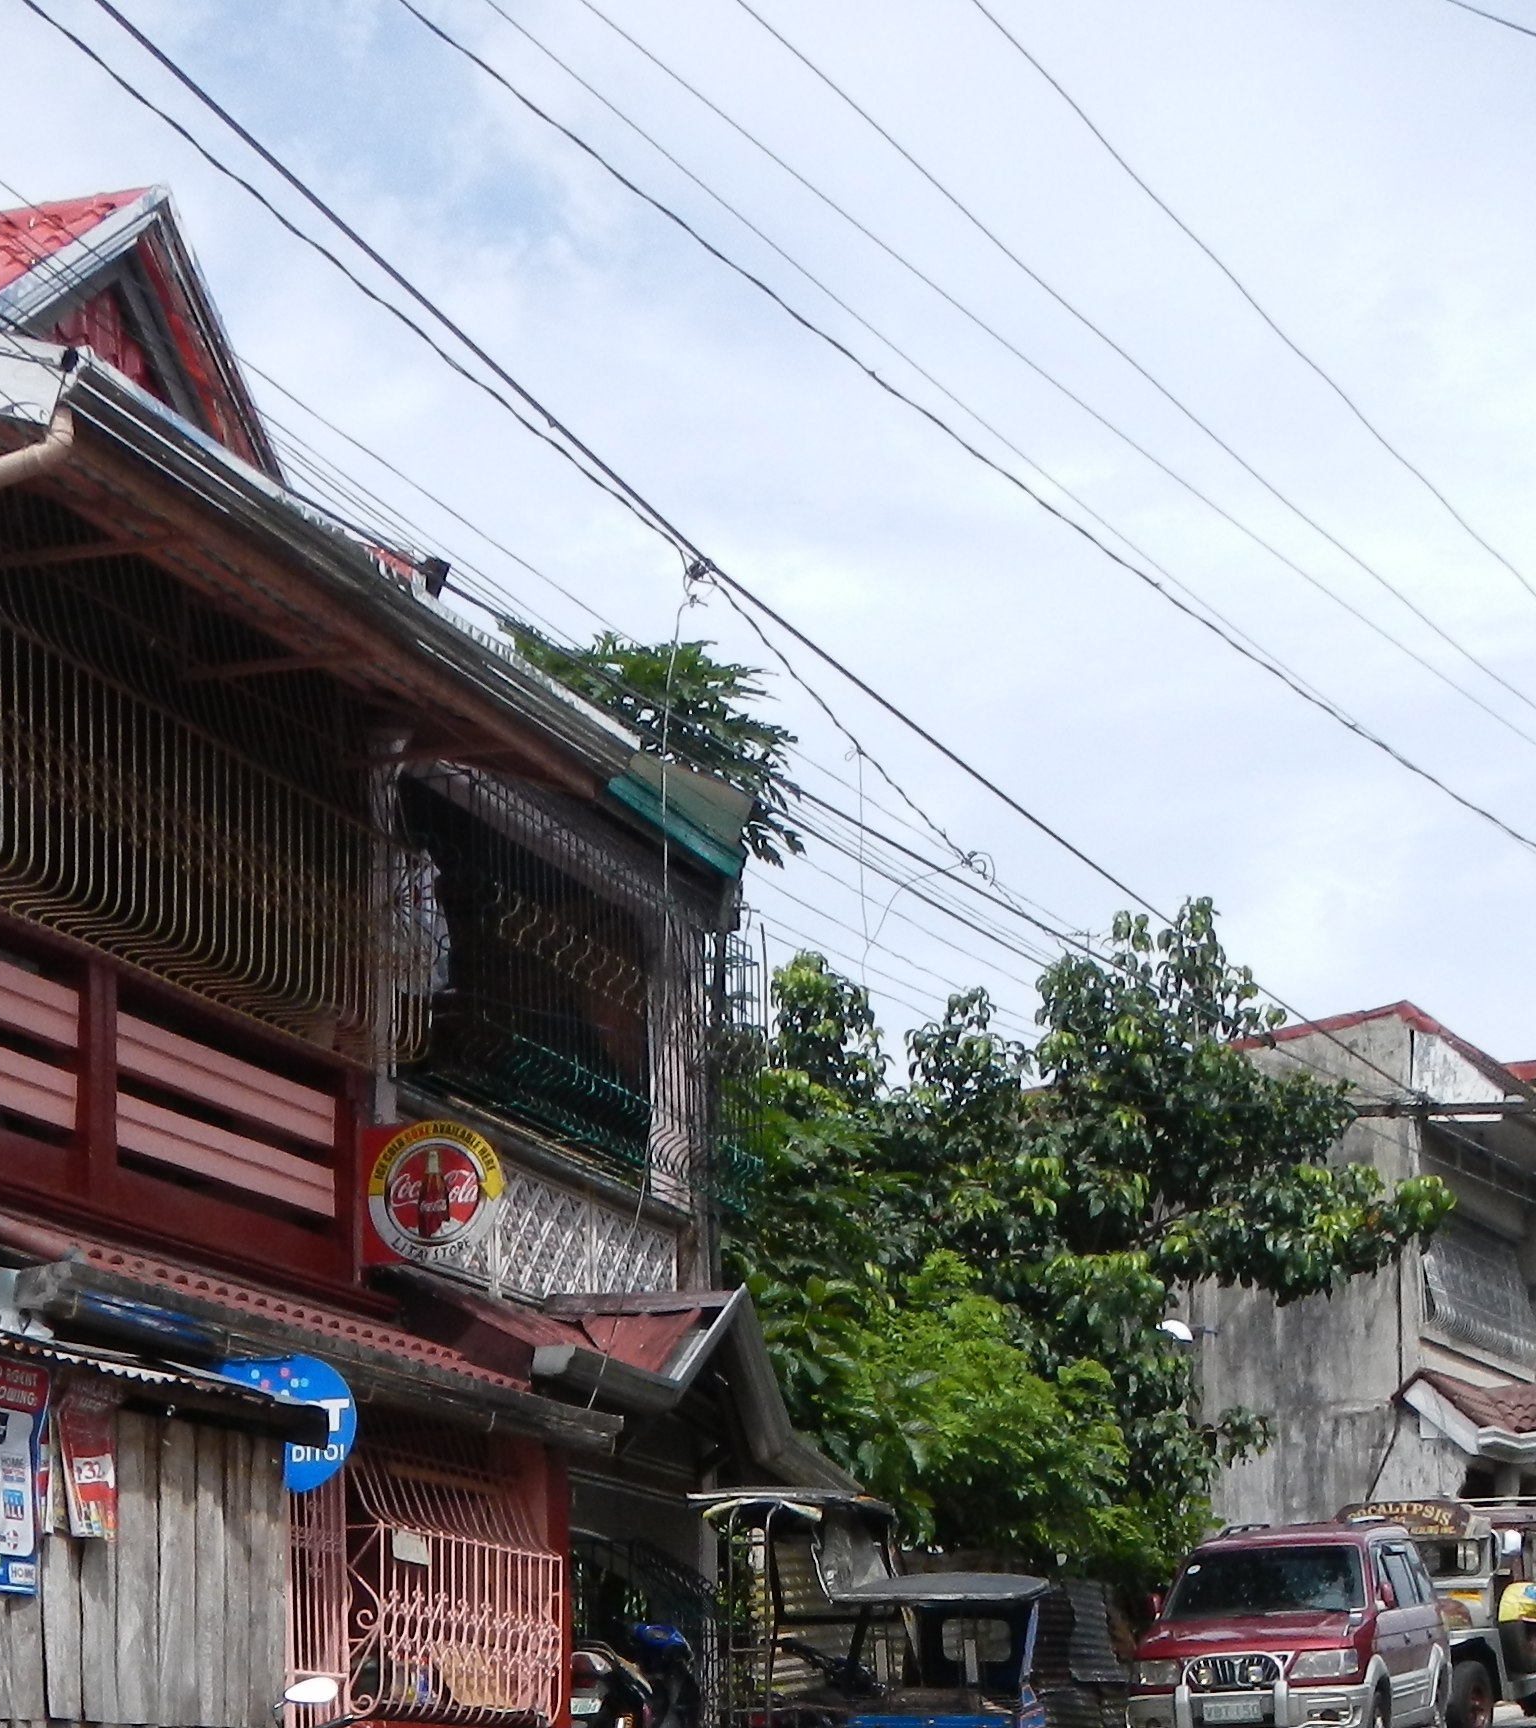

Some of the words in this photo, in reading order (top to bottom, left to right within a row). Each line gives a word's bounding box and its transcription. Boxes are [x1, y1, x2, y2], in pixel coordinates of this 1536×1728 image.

[432, 1122, 482, 1150] AVAILABLE
[433, 1238, 472, 1260] STORE
[291, 1444, 344, 1462] DITO!
[11, 1568, 35, 1579] HOME
